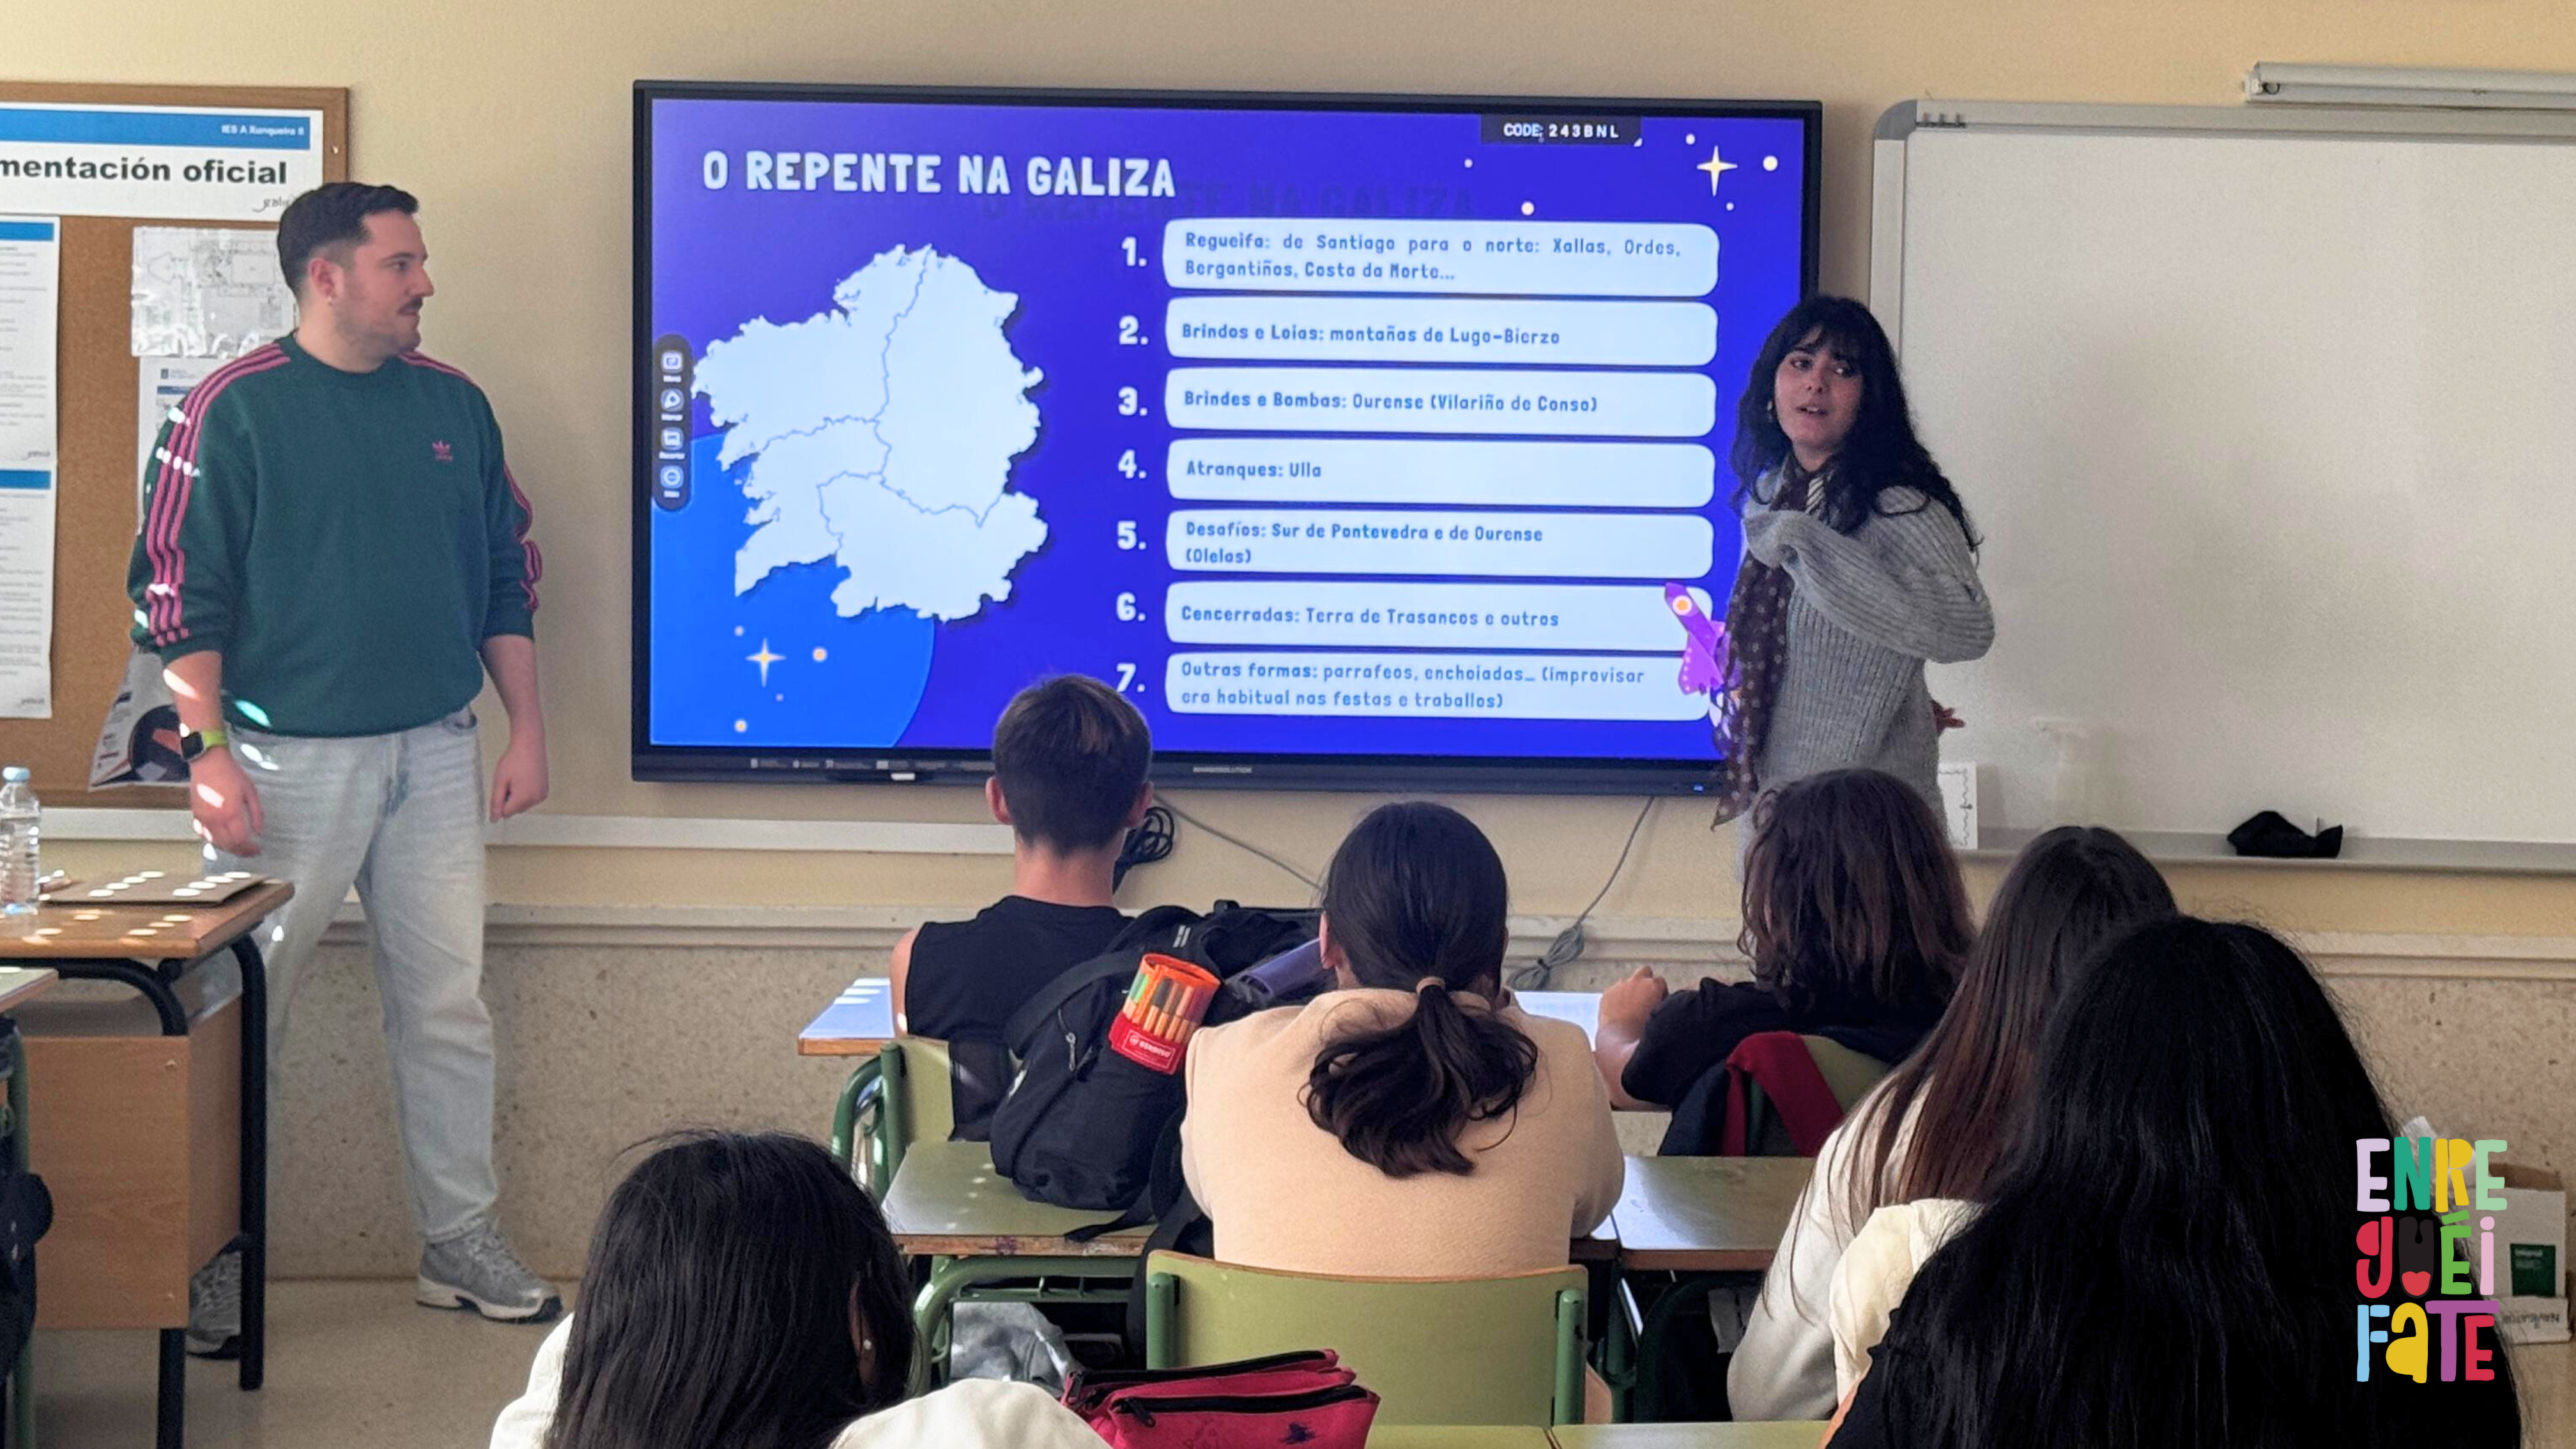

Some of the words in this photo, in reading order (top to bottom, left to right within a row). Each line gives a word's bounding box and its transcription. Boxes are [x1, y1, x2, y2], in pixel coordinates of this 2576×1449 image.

[239, 125, 248, 134] A
[183, 159, 288, 185] oficial
[703, 150, 729, 190] O
[746, 151, 942, 193] REPENTE
[959, 155, 1011, 195] NA
[1027, 157, 1177, 197] GALIZA
[1121, 236, 1147, 266] 1.
[1186, 232, 1271, 251] Regueifa:
[1283, 234, 1303, 249] de
[1316, 234, 1395, 254] Santiago
[1409, 240, 1448, 255] para
[1463, 240, 1471, 252] o
[1486, 238, 1540, 253] norte:
[1553, 238, 1612, 256] Xallas,
[1625, 239, 1681, 257] Ordes,
[1186, 259, 1299, 280] Bergantiños,
[1305, 261, 1355, 277] Costa
[1363, 263, 1383, 277] da
[1119, 316, 1149, 345] 2.
[1255, 328, 1264, 340] e
[1271, 325, 1324, 341] Loias:
[1330, 325, 1416, 342] montañas
[1424, 327, 1443, 342] de
[1450, 327, 1559, 346] Lugo-Bierzo
[1118, 387, 1148, 416] 3.
[1184, 390, 1250, 406] Brindes
[1257, 395, 1266, 406] e
[1273, 392, 1347, 408] Bombas:
[1353, 393, 1423, 410] Ourense
[1431, 394, 1504, 411] (Vilariño
[1511, 395, 1531, 411] de
[1538, 395, 1598, 412] Conso)
[1117, 450, 1147, 479] 4.
[1187, 460, 1284, 480] Atranques:
[1289, 462, 1321, 478] Ulla
[1117, 521, 1147, 550] 5.
[1186, 521, 1266, 538] Desafíos:
[1271, 523, 1300, 538] Sur
[1306, 523, 1325, 538] de
[1331, 523, 1428, 539] Pontevedra
[1434, 528, 1443, 540] e
[1449, 525, 1468, 540] de
[1475, 526, 1542, 542] Ourense
[1186, 548, 1252, 564] (Olelas)
[1117, 592, 1147, 622] 6.
[1181, 605, 1300, 623] Cencerradas:
[1306, 608, 1353, 623] Terra
[1360, 608, 1380, 624] de
[1387, 609, 1478, 625] Trasancos
[1501, 611, 1559, 627] outros
[1117, 663, 1146, 692] 7.
[1181, 661, 1241, 677] Outras
[1248, 663, 1318, 678] formas:
[1324, 664, 1419, 682] parrafeos,
[1542, 666, 1644, 686] (improvisar
[1218, 689, 1289, 705] habitual
[1296, 694, 1326, 706] nas
[1334, 691, 1392, 706] festas
[1414, 692, 1503, 709] traballos)
